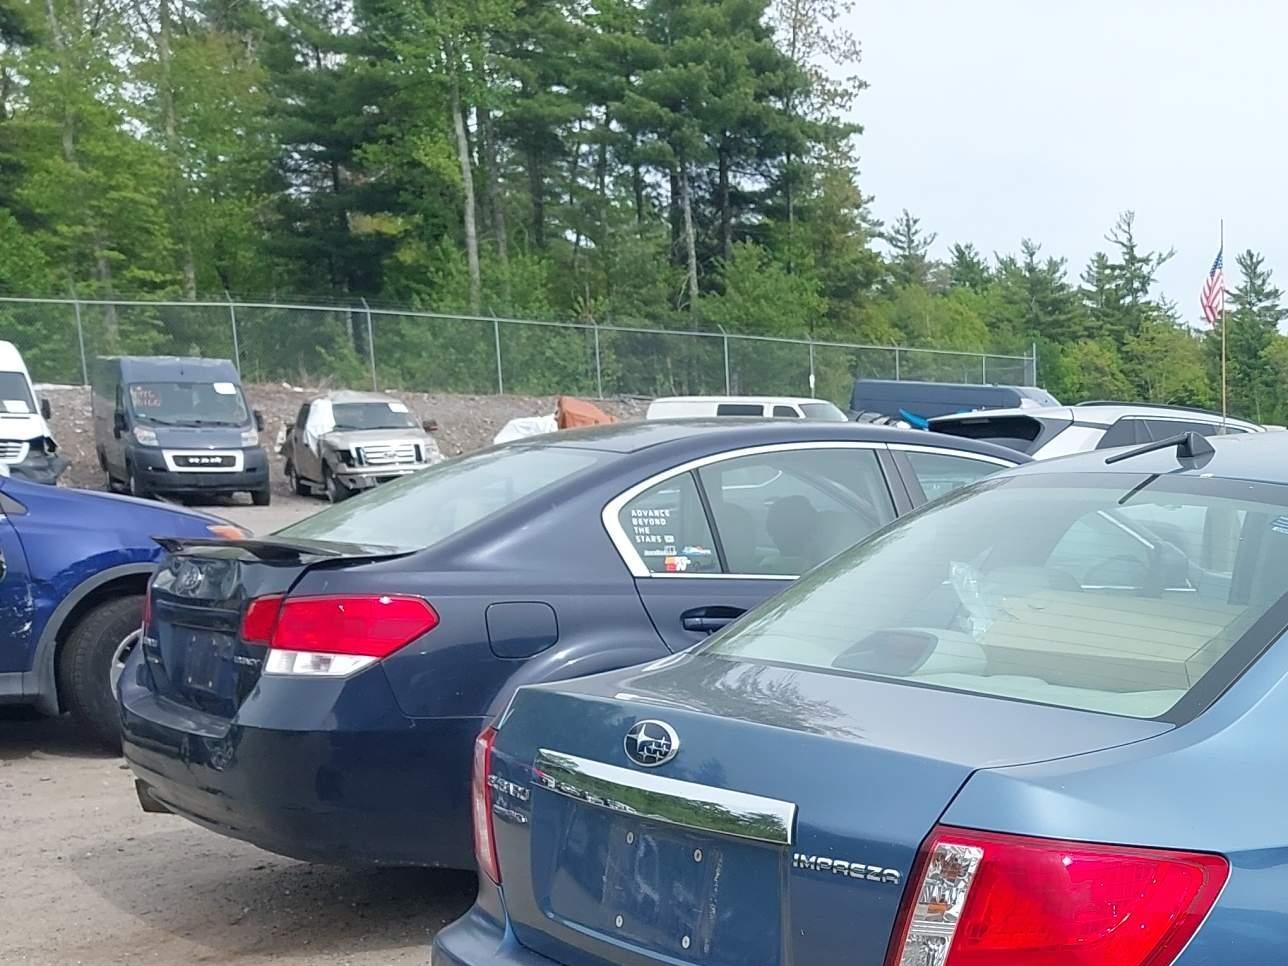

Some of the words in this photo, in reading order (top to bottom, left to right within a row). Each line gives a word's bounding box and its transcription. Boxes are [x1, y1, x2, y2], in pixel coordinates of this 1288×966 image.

[631, 509, 670, 517] ADVANCE
[631, 518, 667, 526] BEYOND
[635, 535, 662, 543] STARS
[792, 852, 901, 885] IMPREZA
